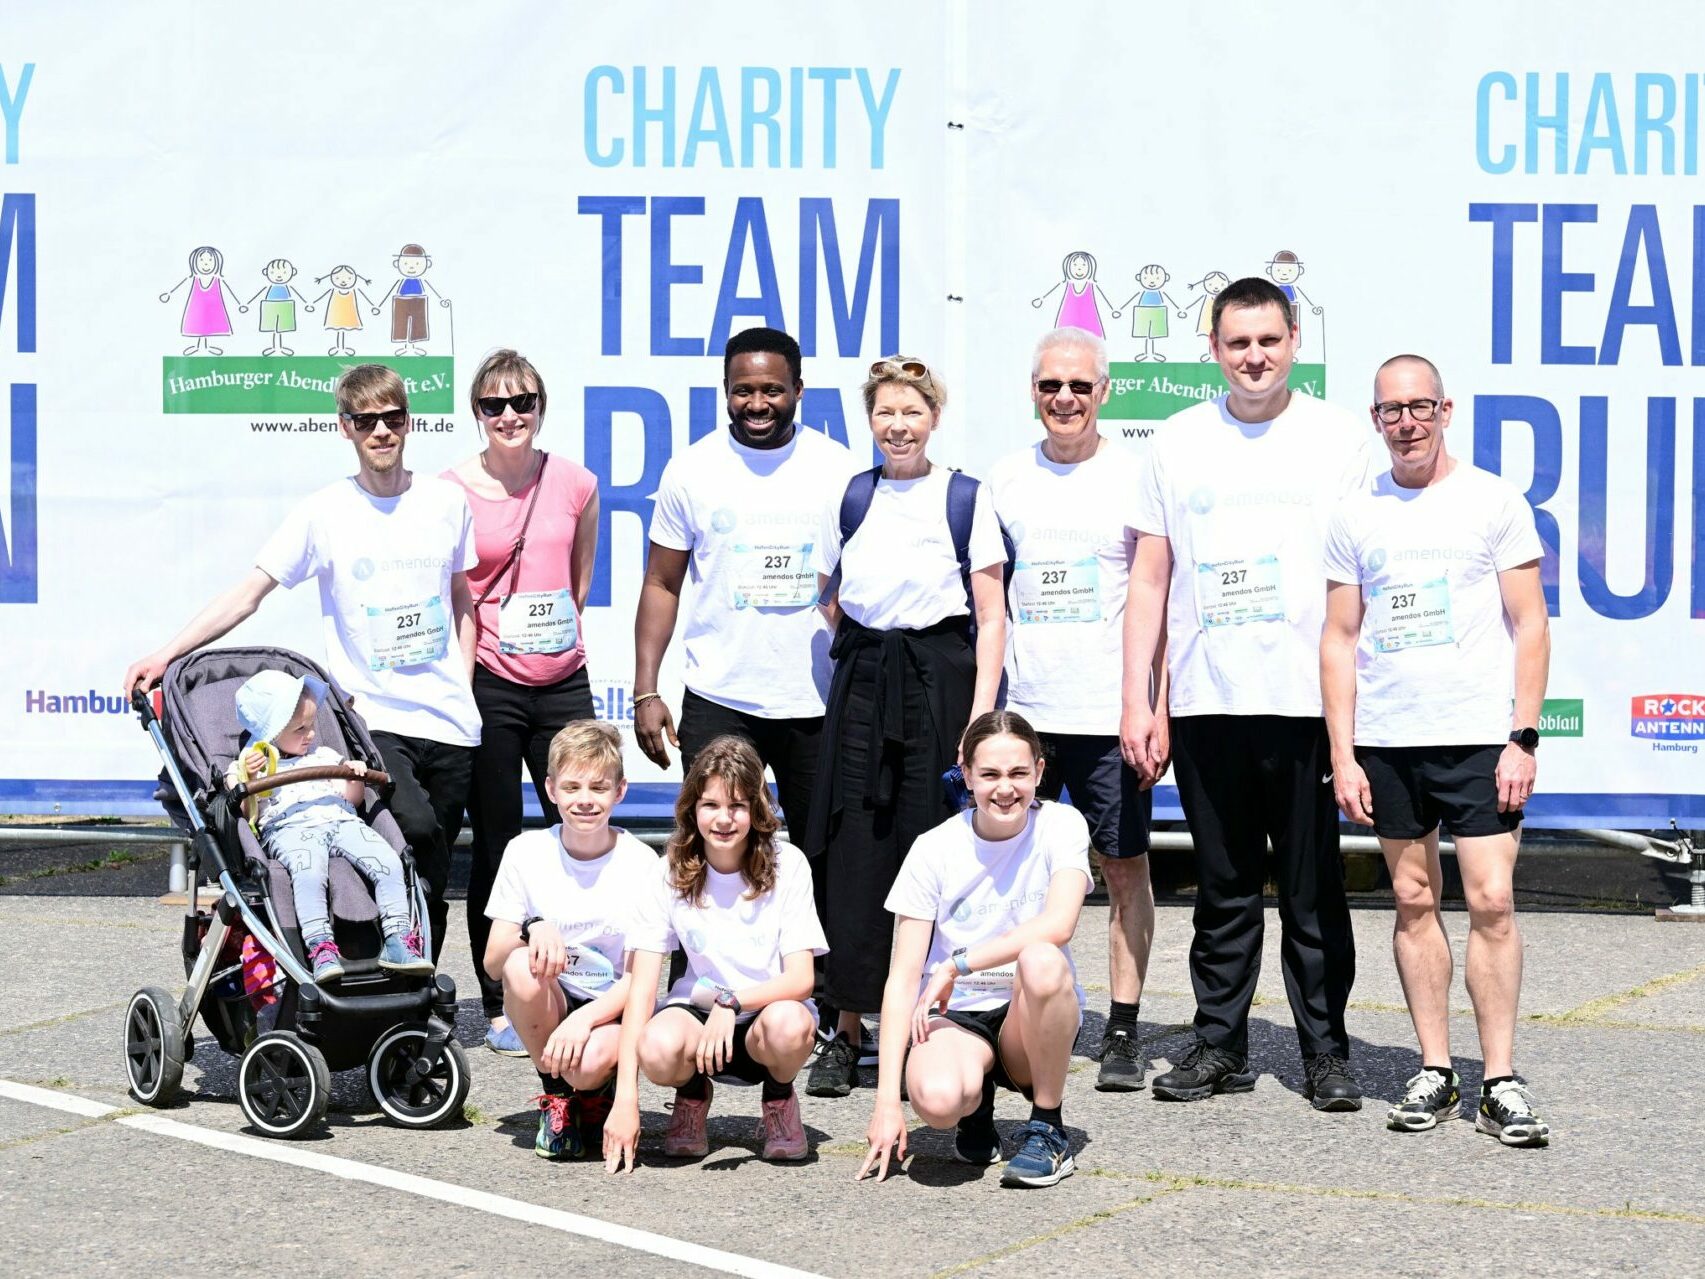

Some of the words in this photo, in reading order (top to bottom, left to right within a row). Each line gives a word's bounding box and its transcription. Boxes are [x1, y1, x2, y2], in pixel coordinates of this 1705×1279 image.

[583, 65, 902, 169] CHARITY
[1475, 71, 1705, 176] CHARI
[577, 195, 901, 358] TEAM
[1468, 202, 1705, 366] TEA
[168, 370, 273, 395] Hamburger
[276, 370, 338, 393] Abend
[421, 373, 450, 391] e.V.
[1147, 376, 1230, 400] Abendbla
[1473, 394, 1705, 621] RU
[744, 512, 821, 526] amendo
[764, 555, 791, 569] 237
[795, 572, 814, 580] GmbH
[1041, 570, 1067, 585] 237
[1221, 569, 1248, 586] 237
[1040, 588, 1071, 597] amendos
[1072, 586, 1094, 594] GmbH
[1221, 588, 1252, 598] amendos
[1253, 584, 1277, 594] GmbH
[528, 602, 554, 617] 237
[1391, 593, 1417, 610] 237
[396, 612, 422, 630] 237
[1391, 612, 1421, 622] amendos
[1422, 608, 1446, 618] GmbH
[527, 620, 556, 628] amendos
[396, 629, 426, 641] amendos
[426, 624, 445, 636] GmbH
[26, 689, 136, 718] Hambur
[1644, 699, 1705, 715] ROCK
[1634, 721, 1705, 734] ANTENN
[1652, 742, 1698, 754] Hamburg
[585, 970, 608, 978] GmbH
